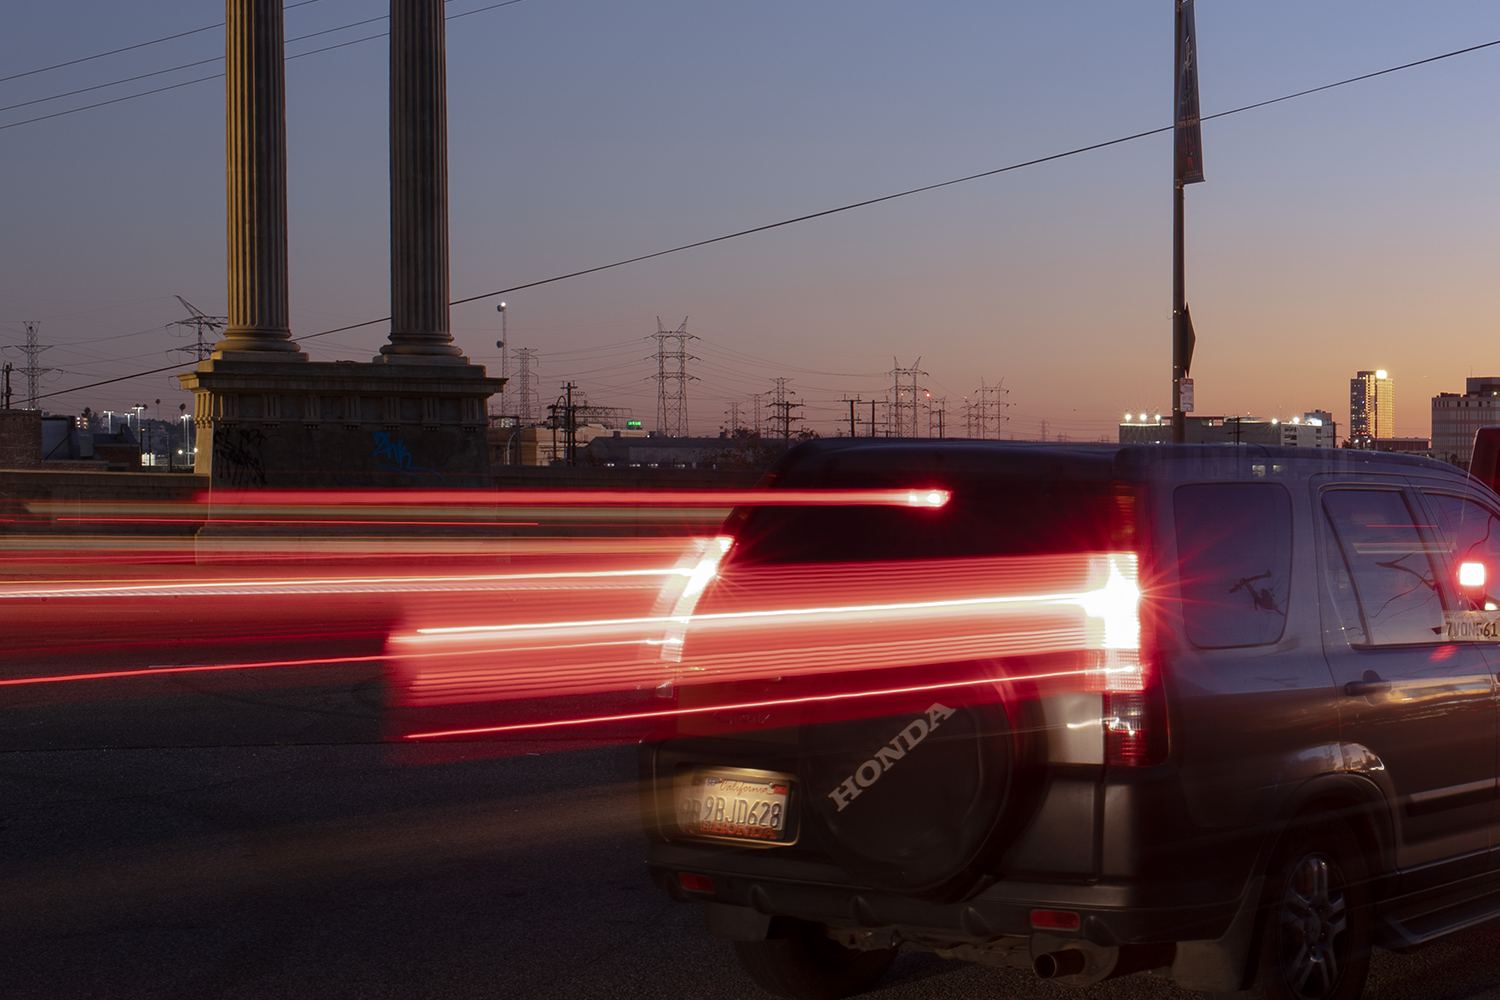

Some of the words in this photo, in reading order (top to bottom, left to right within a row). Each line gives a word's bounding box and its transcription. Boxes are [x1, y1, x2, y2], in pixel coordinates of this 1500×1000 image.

[828, 702, 956, 812] HONDA
[720, 780, 774, 796] California
[704, 795, 782, 828] 9BJD628
[711, 821, 777, 840] HONDA
